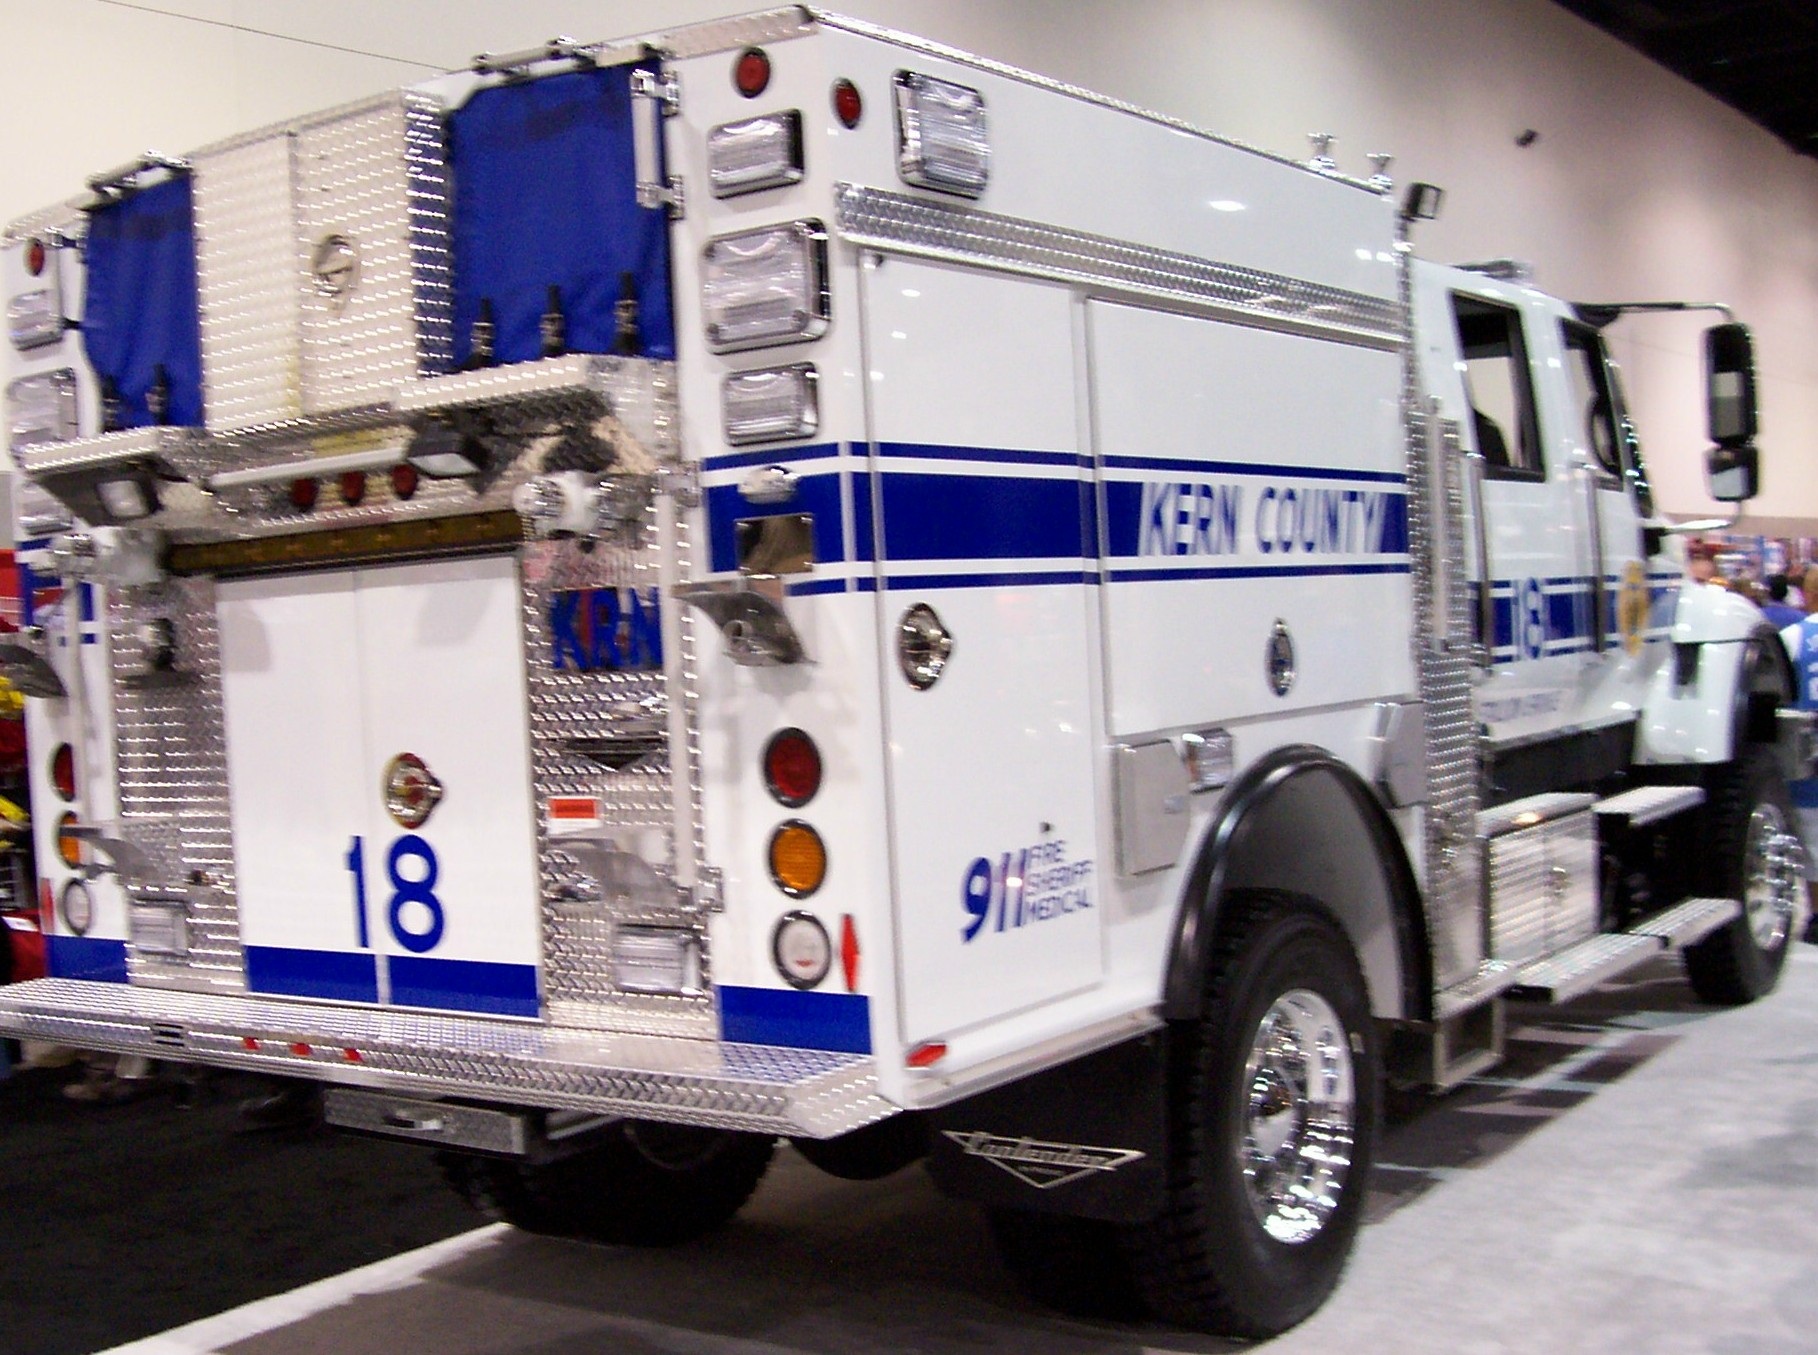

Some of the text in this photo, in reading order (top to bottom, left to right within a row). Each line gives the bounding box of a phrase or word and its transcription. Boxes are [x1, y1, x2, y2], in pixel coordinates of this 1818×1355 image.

[1146, 482, 1382, 556] KERN COUNTY
[1509, 577, 1544, 664] 18
[344, 834, 444, 953] 18
[961, 848, 1028, 943] 911
